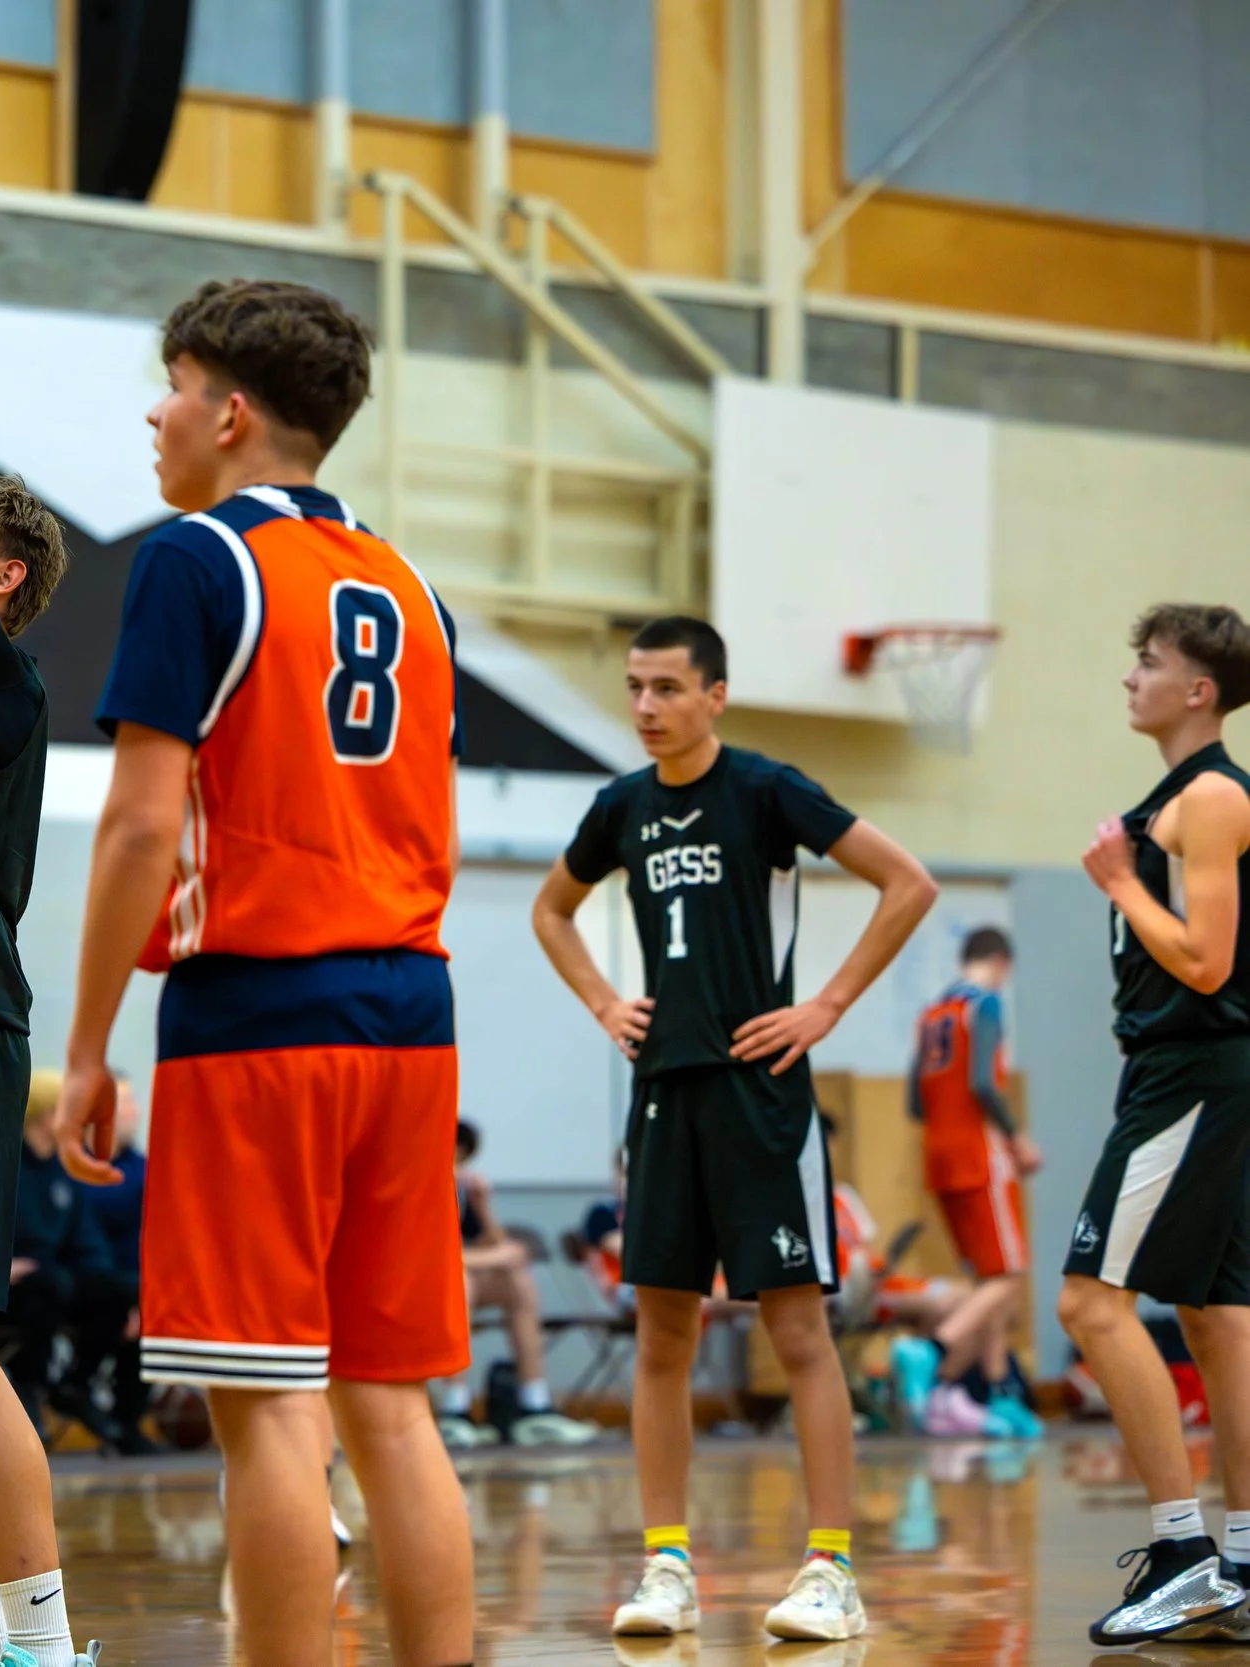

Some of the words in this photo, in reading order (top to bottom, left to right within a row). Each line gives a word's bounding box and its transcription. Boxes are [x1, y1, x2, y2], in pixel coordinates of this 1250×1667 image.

[322, 578, 405, 766] 8
[645, 843, 723, 893] GESS
[667, 896, 688, 959] 1
